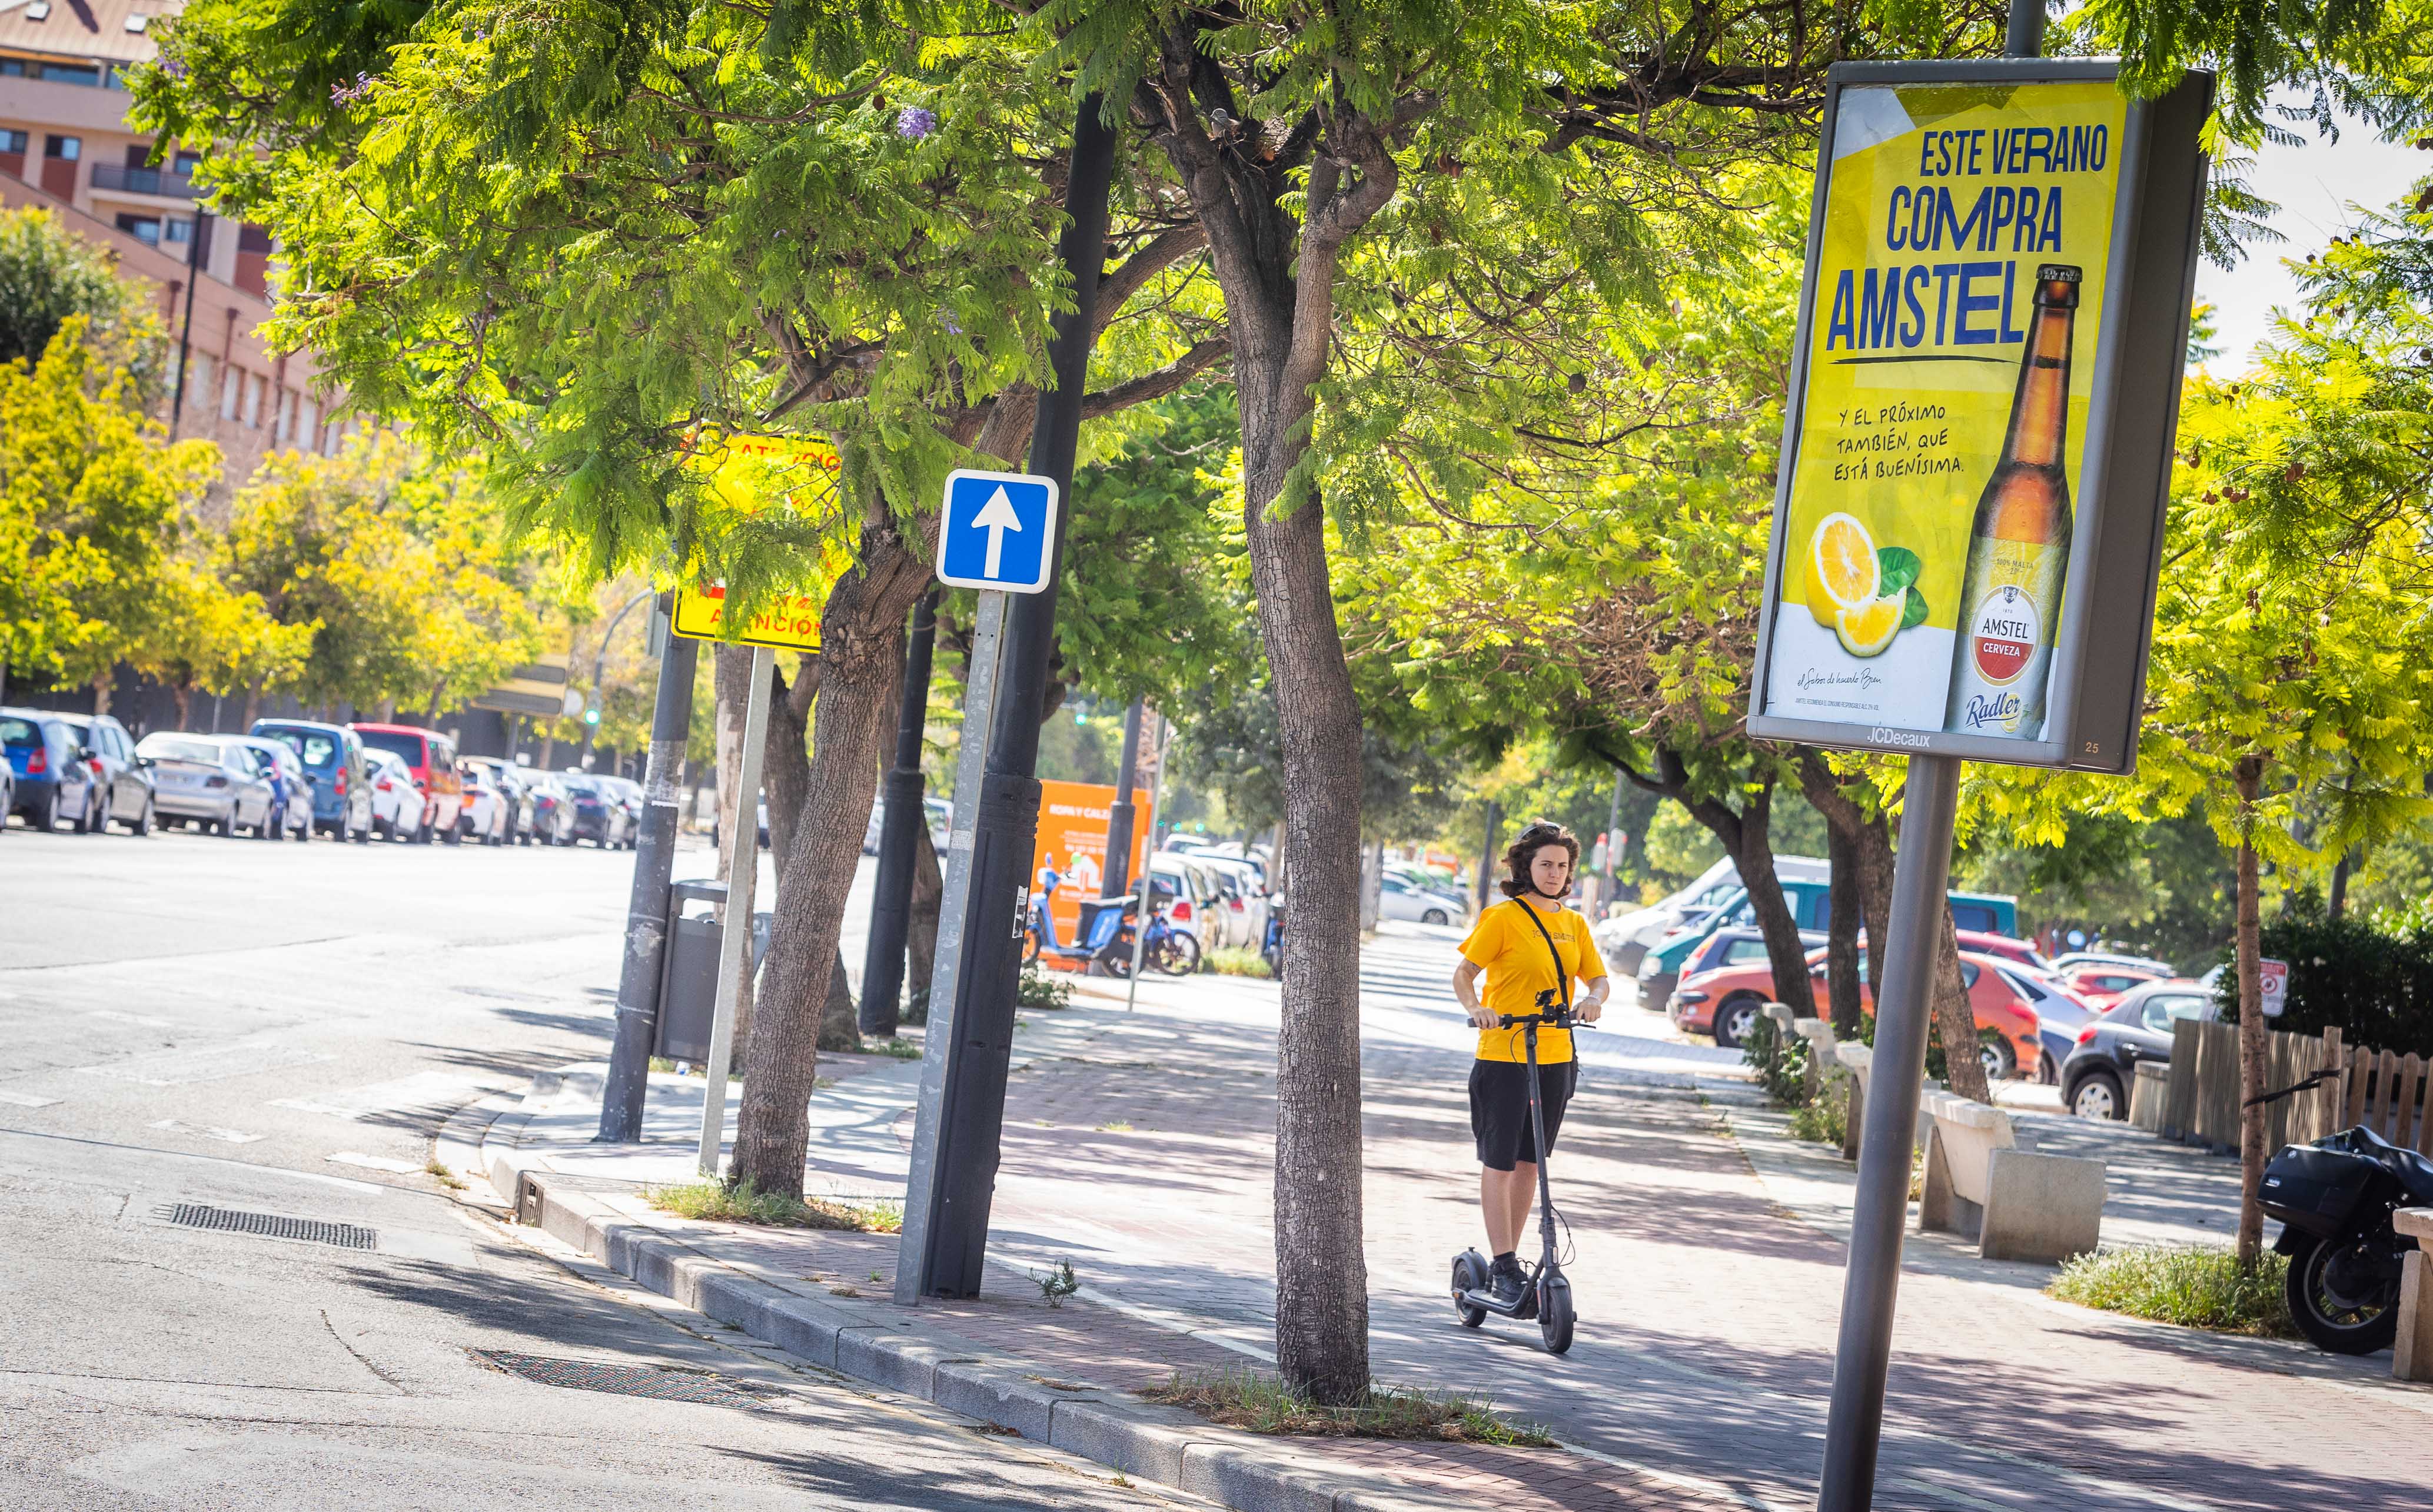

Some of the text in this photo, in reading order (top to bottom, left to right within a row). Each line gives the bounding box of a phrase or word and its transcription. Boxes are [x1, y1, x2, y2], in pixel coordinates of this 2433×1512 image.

[1920, 124, 2108, 177] ESTE VERANO
[1886, 185, 2062, 252] COMPRA
[1826, 261, 2025, 351] AMSTEL
[1839, 401, 1946, 427] Y EL PRÓXIMO
[1837, 427, 1948, 454] TAMBIÉN, QUE
[1834, 453, 1965, 480] ESTÁ BUENÍSIMA.
[2013, 560, 2034, 570] MALTA
[1982, 617, 2029, 639] AMSTEL
[1983, 642, 2020, 657] CERVEZA
[1827, 673, 1834, 684] de
[1966, 692, 2020, 728] Radler
[1867, 727, 1930, 747] JCDecaux
[2085, 741, 2099, 754] 25
